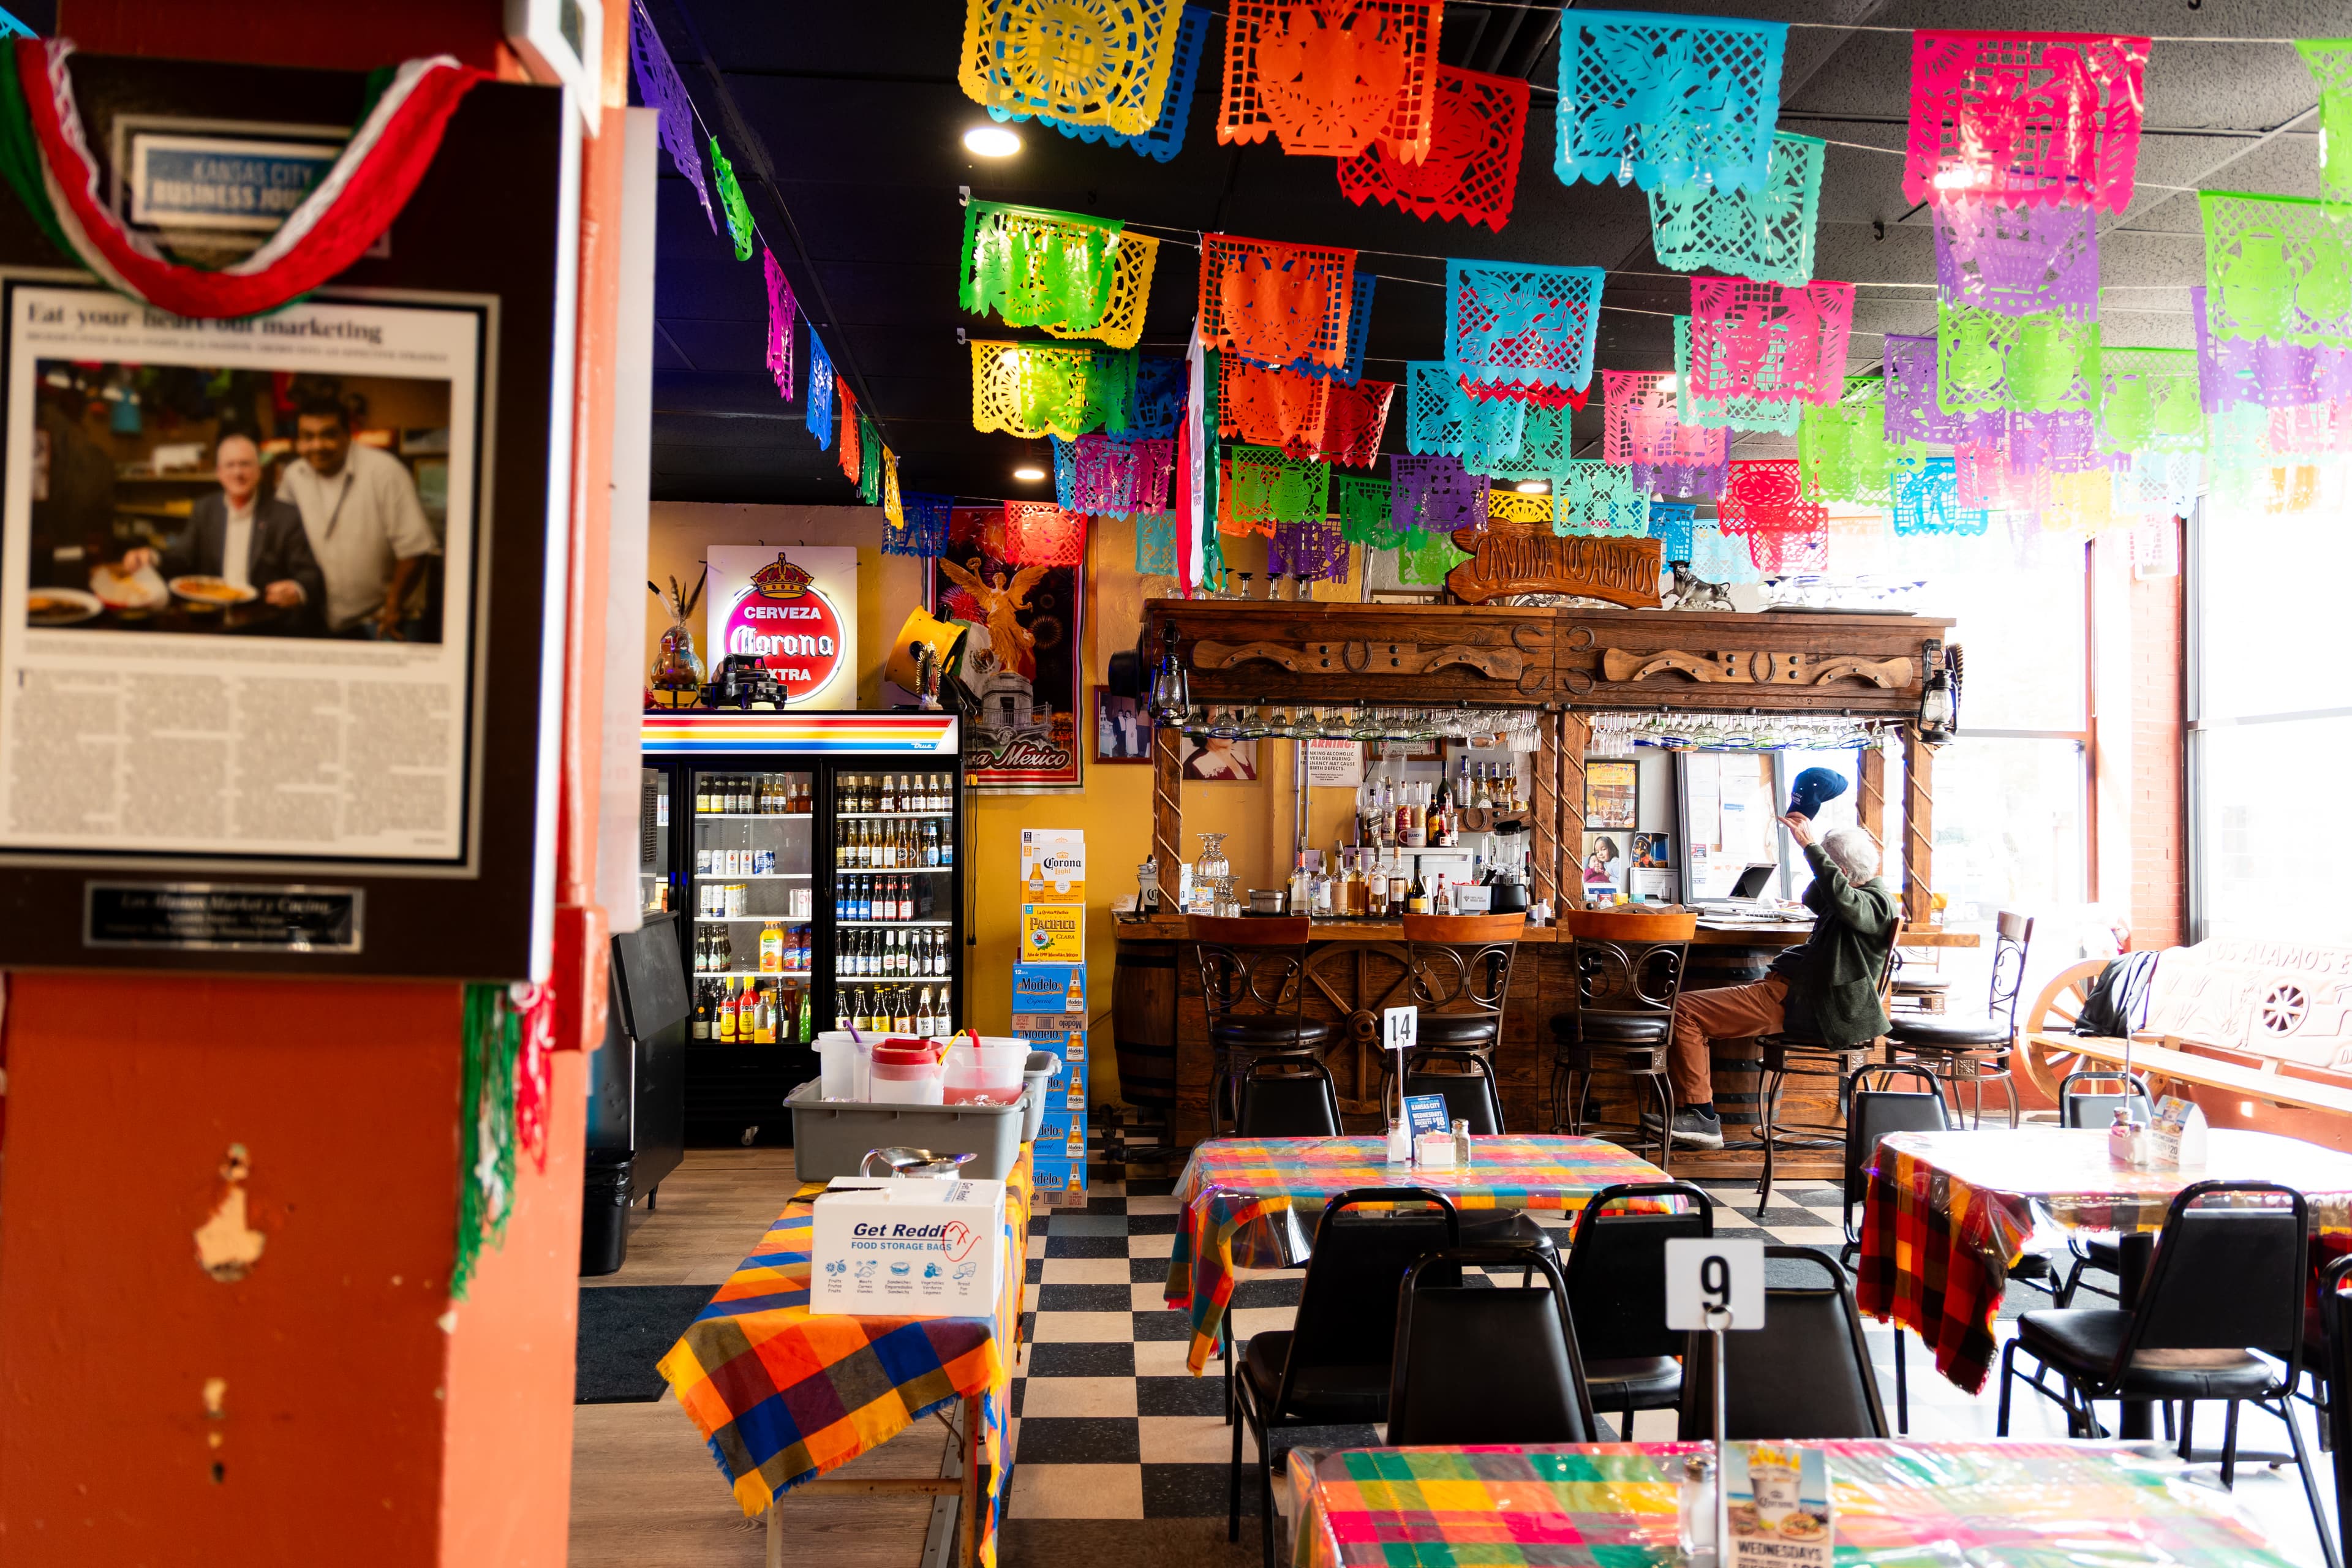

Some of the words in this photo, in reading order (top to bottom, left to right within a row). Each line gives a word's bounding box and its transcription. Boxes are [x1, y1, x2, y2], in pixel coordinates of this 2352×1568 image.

[192, 158, 265, 185] KANSAS
[271, 162, 311, 187] CITY
[152, 178, 255, 209] BUSINESS
[28, 303, 64, 322] Eat
[77, 308, 130, 332] your
[262, 317, 383, 344] marketing
[1475, 535, 1556, 581] CANTINA
[1562, 537, 1591, 579] LOS
[1587, 541, 1660, 595] ALAMOS
[744, 606, 821, 619] CERVEZA
[730, 625, 833, 657] Corona
[766, 668, 812, 681] XTRA
[995, 744, 1066, 766] México
[1043, 857, 1081, 870] Corona
[1022, 978, 1058, 990] Modelo
[1059, 1020, 1082, 1029] Modelo
[1391, 1014, 1411, 1041] 14
[1047, 1077, 1059, 1088] elo
[1038, 1124, 1059, 1136] delo
[1033, 1143, 1054, 1152] special
[1032, 1173, 1058, 1185] odelo
[853, 1223, 887, 1237] Get
[892, 1223, 948, 1238] Reddi
[880, 1242, 924, 1251] STORAGE
[1700, 1255, 1731, 1313] 9
[1737, 1540, 1823, 1561] WEDNESDAYS
